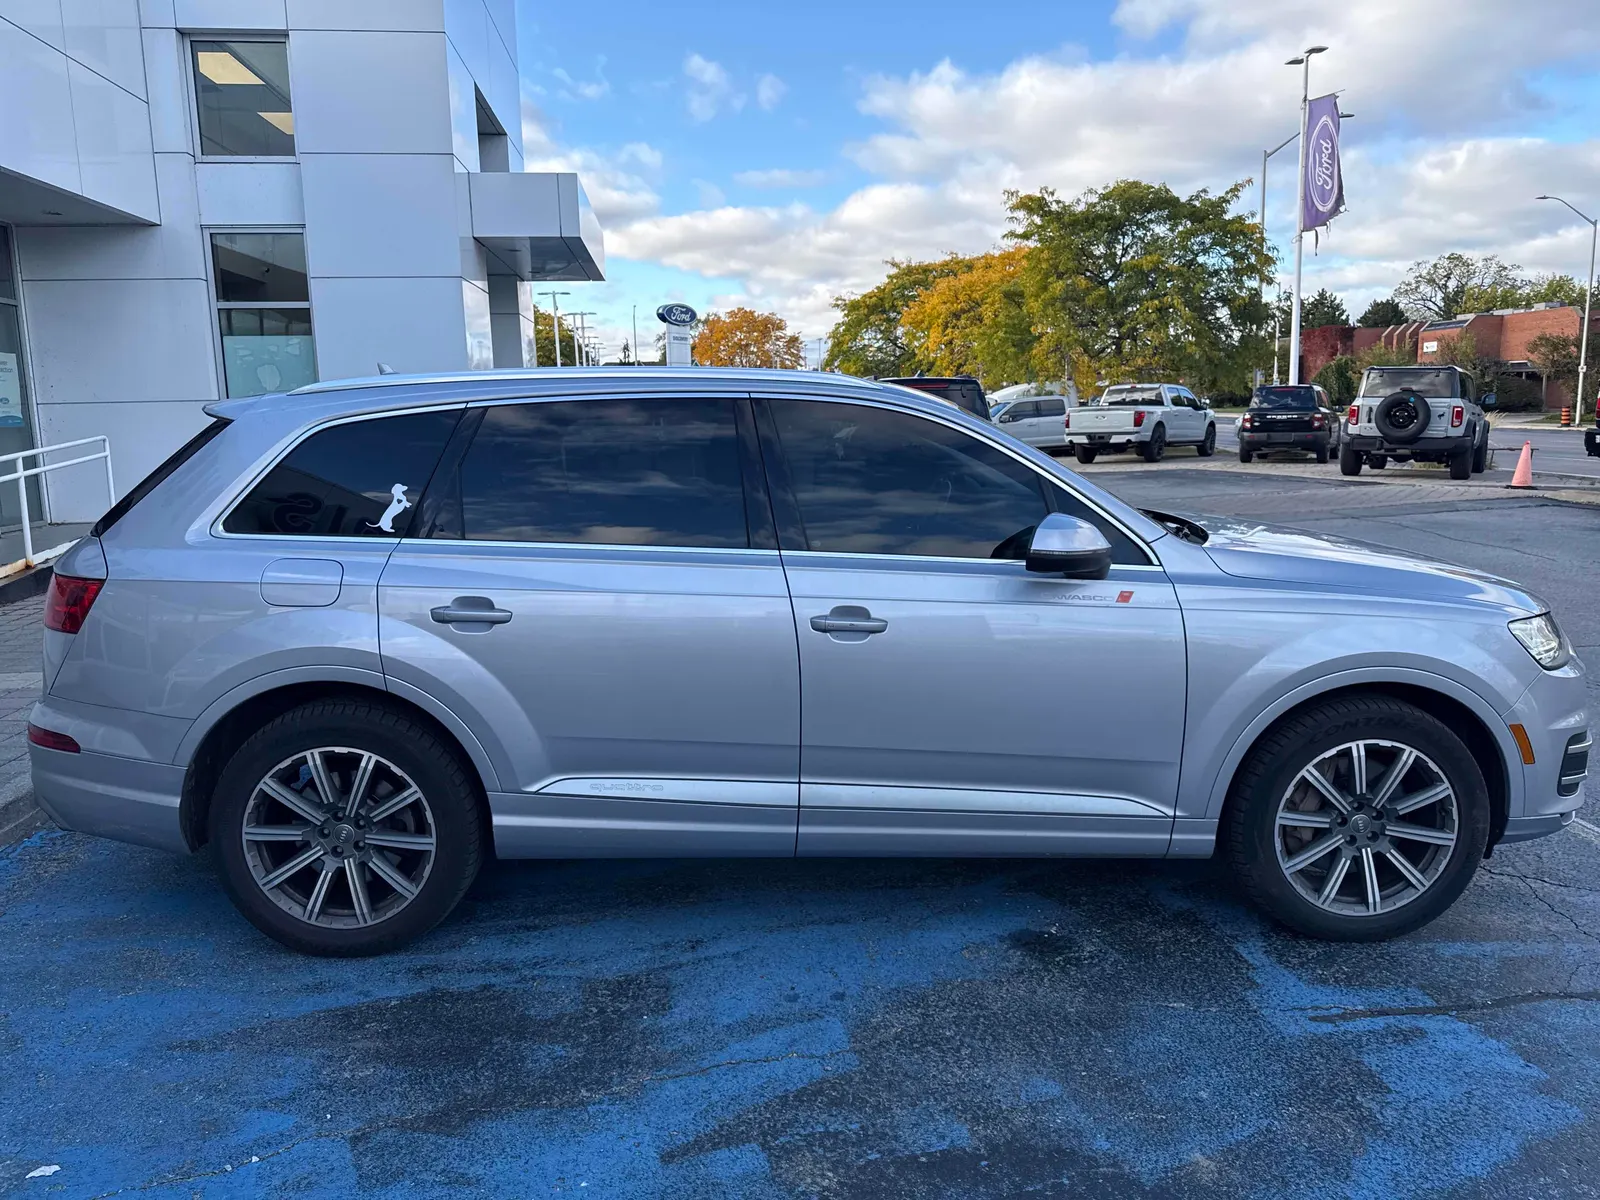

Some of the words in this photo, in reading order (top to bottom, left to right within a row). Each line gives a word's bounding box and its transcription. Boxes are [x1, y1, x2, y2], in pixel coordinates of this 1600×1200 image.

[1315, 138, 1333, 190] Ford
[671, 306, 692, 321] Ford
[589, 782, 664, 792] quattro
